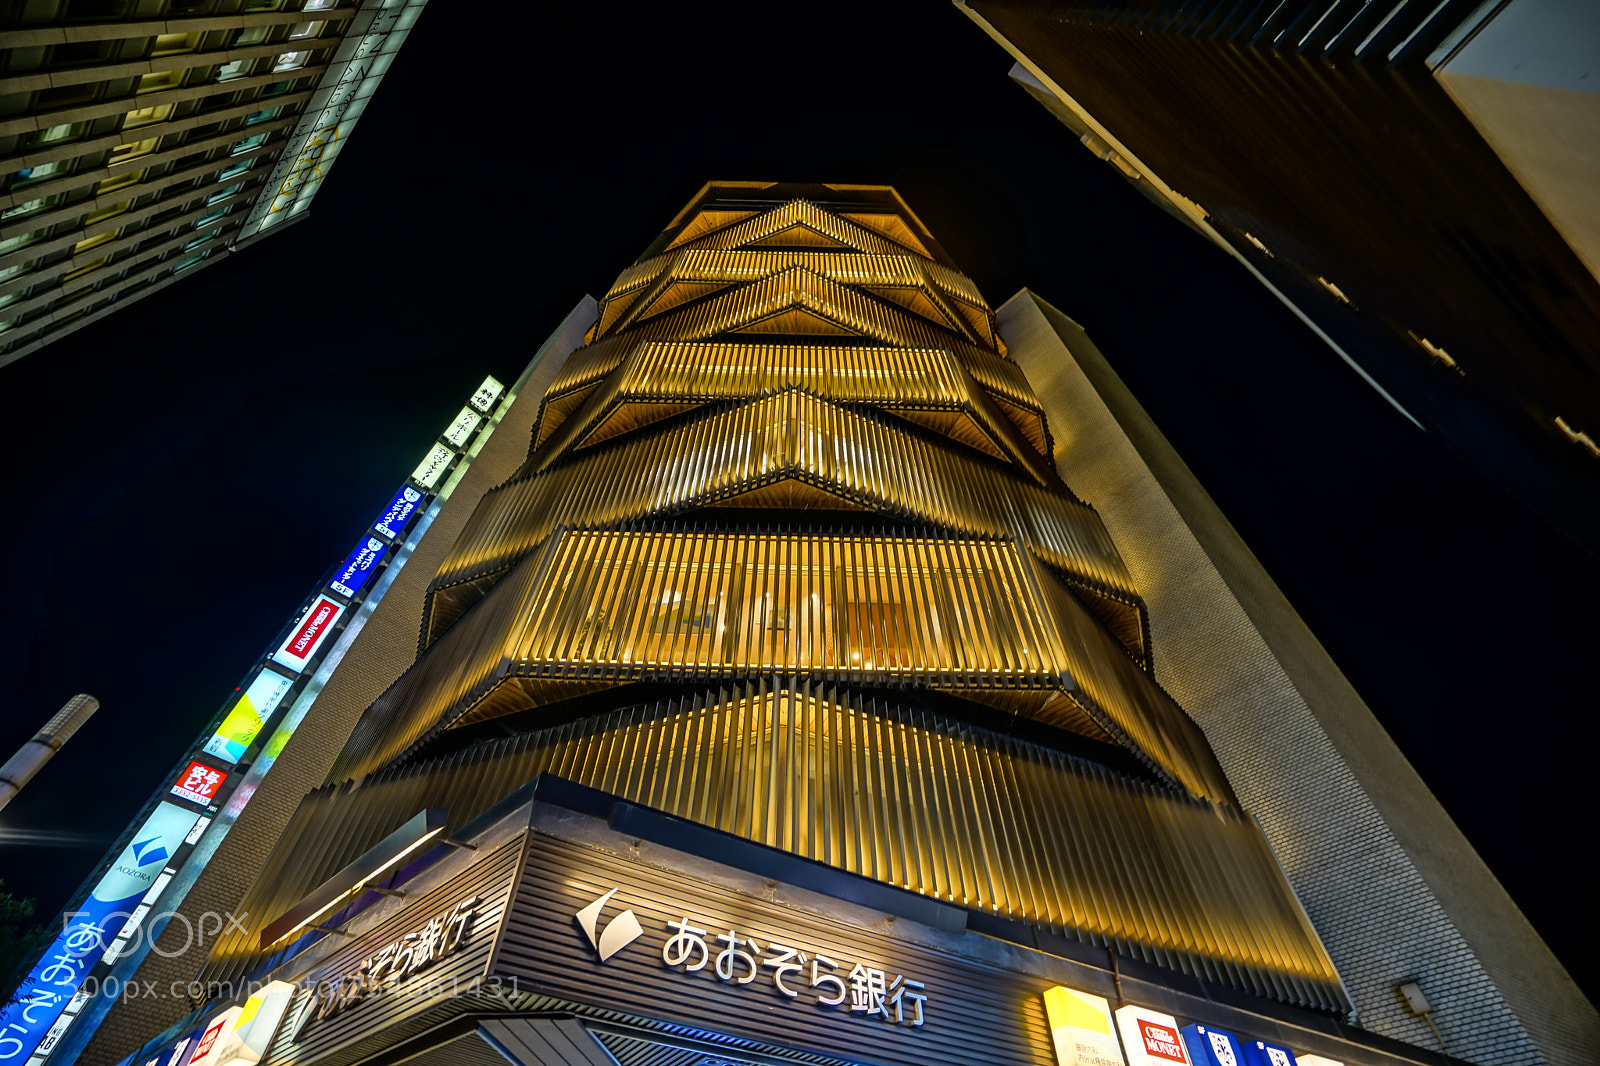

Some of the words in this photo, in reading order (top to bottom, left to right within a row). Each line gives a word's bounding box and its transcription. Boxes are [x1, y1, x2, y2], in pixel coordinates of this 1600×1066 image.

[354, 8, 388, 59] DRUG
[330, 66, 354, 104] AND
[294, 623, 319, 652] MONET
[183, 776, 212, 796] ビル
[116, 865, 151, 882] AOZORA
[662, 916, 928, 1027] あおぞら銀行
[1144, 1037, 1182, 1058] MONET
